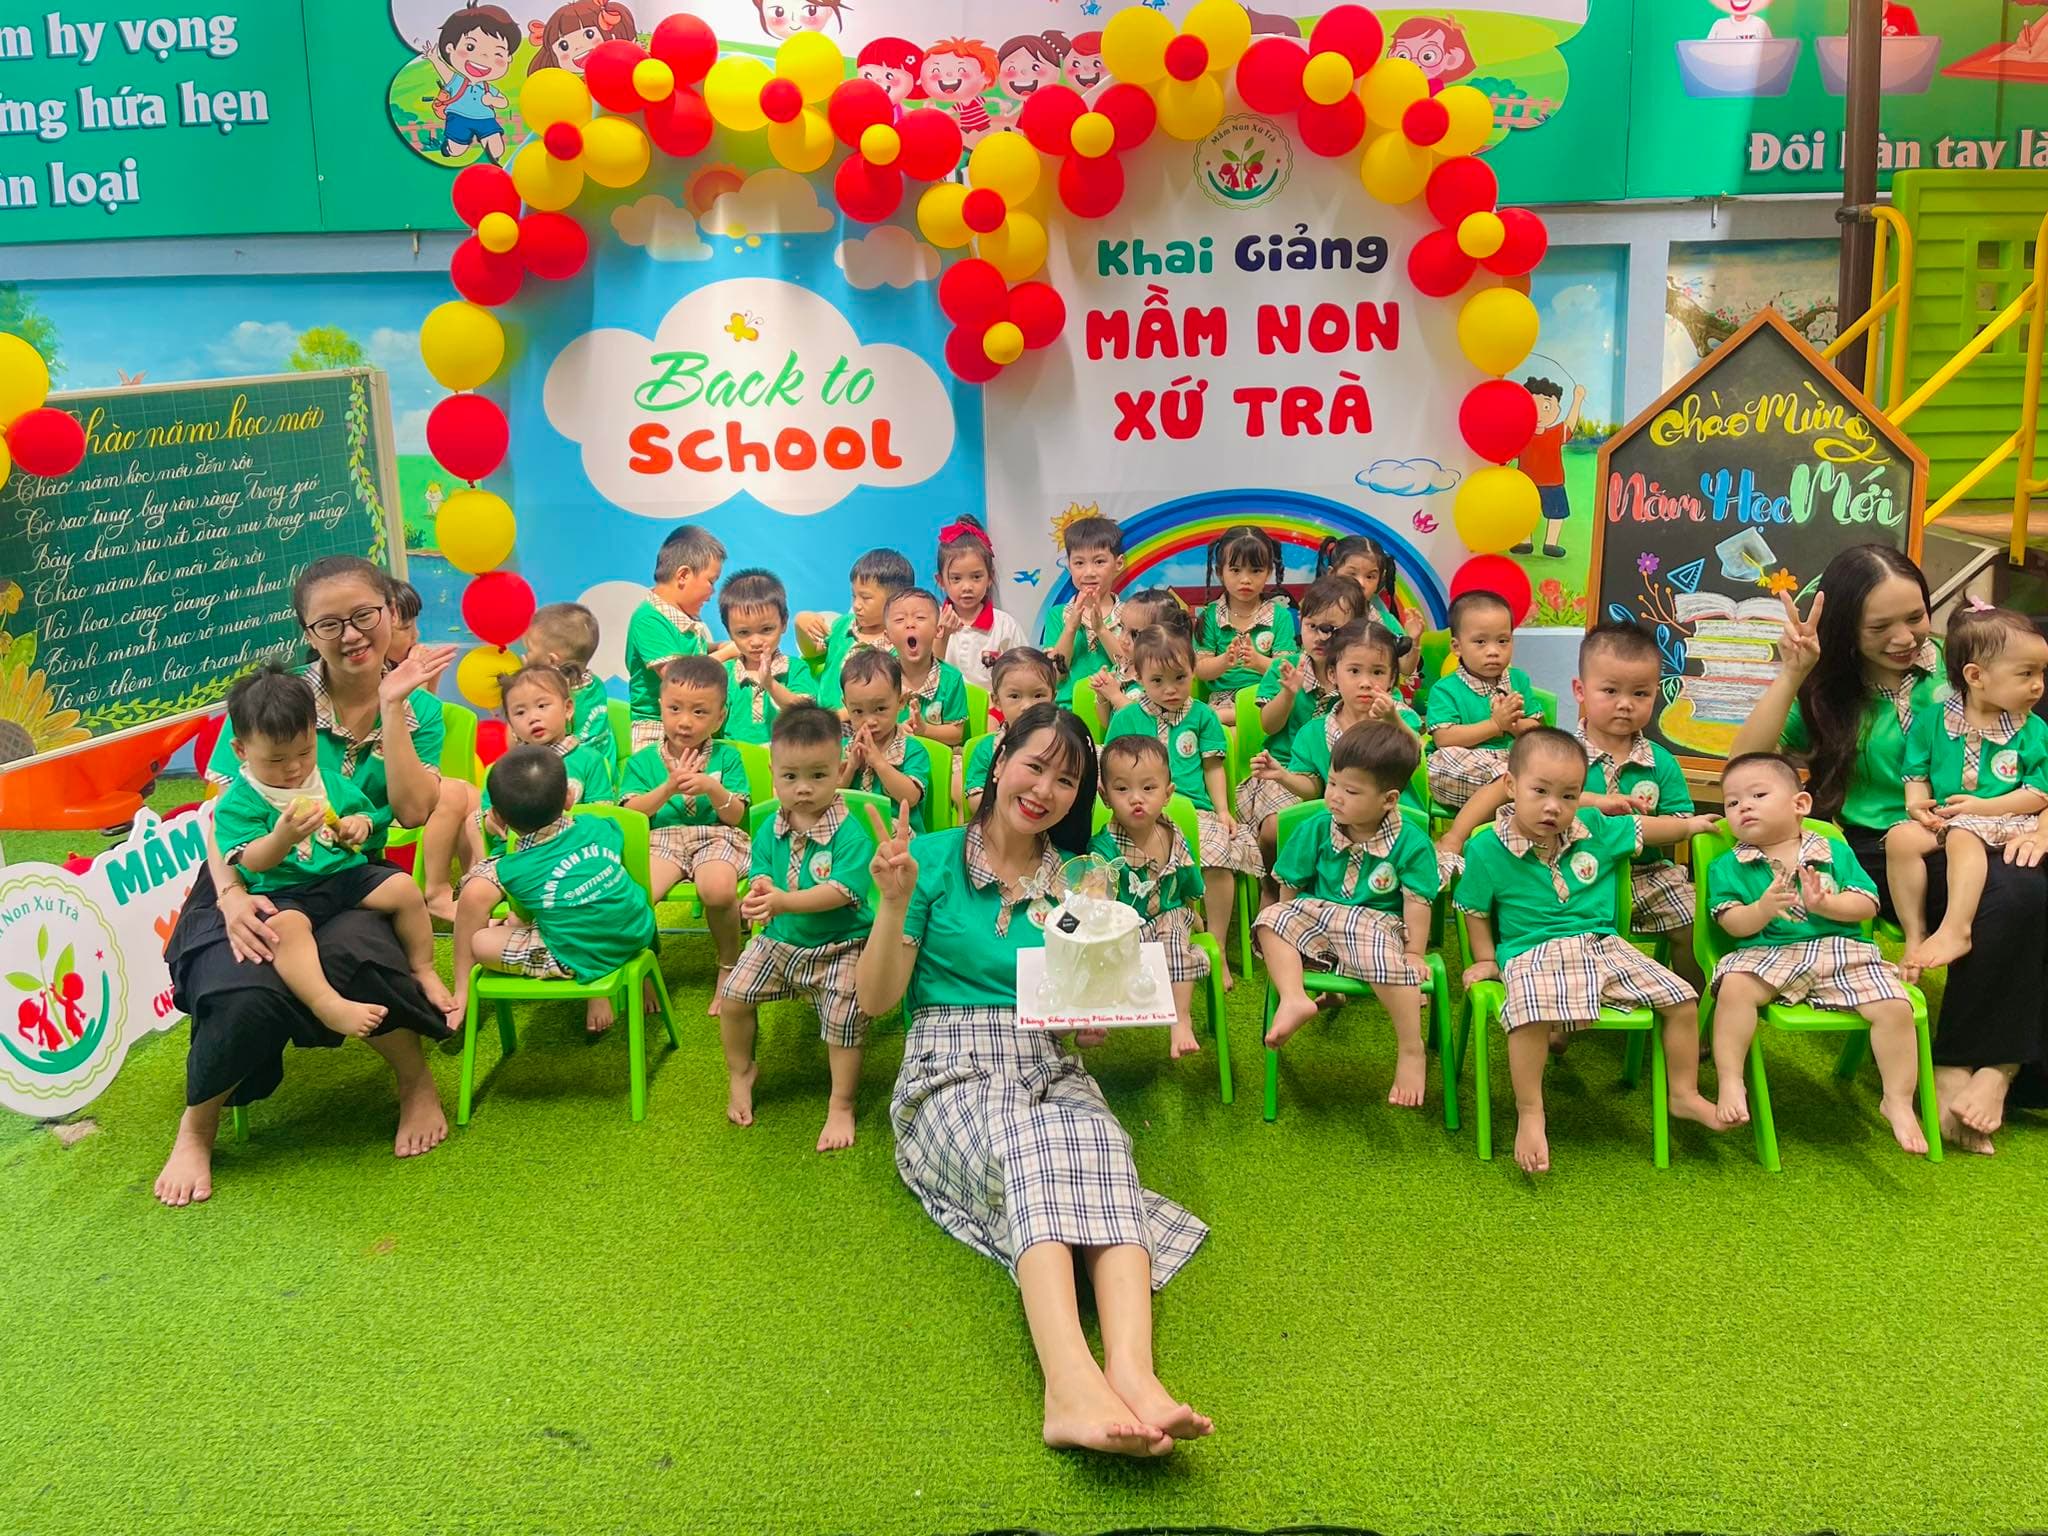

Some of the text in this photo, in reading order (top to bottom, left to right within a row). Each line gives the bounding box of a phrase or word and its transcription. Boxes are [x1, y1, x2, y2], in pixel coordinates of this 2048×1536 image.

[46, 12, 106, 63] hy
[118, 15, 239, 60] vọng
[79, 86, 167, 129] hứa
[180, 81, 269, 133] hẹn
[1749, 130, 1825, 171] Đôi
[1840, 131, 1920, 169] àn
[1936, 136, 2007, 170] tay
[50, 157, 141, 211] loại
[1097, 222, 1389, 276] Khai Giảng
[1086, 283, 1400, 361] MẦM NON
[633, 349, 876, 412] Back to
[1113, 369, 1373, 442] XỨ TRÀ
[70, 393, 325, 455] hào năm học mới
[1649, 381, 1893, 464] Chào Mừng
[4, 472, 74, 505] Chào
[76, 474, 122, 491] năm
[123, 459, 155, 488] học
[155, 463, 193, 481] mới
[56, 514, 89, 531] sao
[136, 489, 166, 530] bay
[200, 489, 244, 519] ràng
[288, 473, 320, 509] gió
[1608, 460, 1905, 534] Năm Học Mới
[80, 535, 130, 562] chim
[162, 524, 191, 547] rít
[261, 512, 305, 541] trong
[28, 578, 88, 607] Chào
[91, 576, 138, 596] năm
[36, 608, 73, 642] Và
[76, 606, 115, 634] hoa
[116, 604, 168, 637] cũng
[242, 571, 286, 597] nhau
[43, 642, 99, 676] Bình
[102, 627, 161, 662] minh
[217, 614, 264, 636] muôn
[102, 668, 155, 697] thêm
[195, 639, 252, 673] tranh
[105, 818, 210, 906] MẦM
[0, 903, 31, 927] Non
[57, 898, 80, 921] Trà
